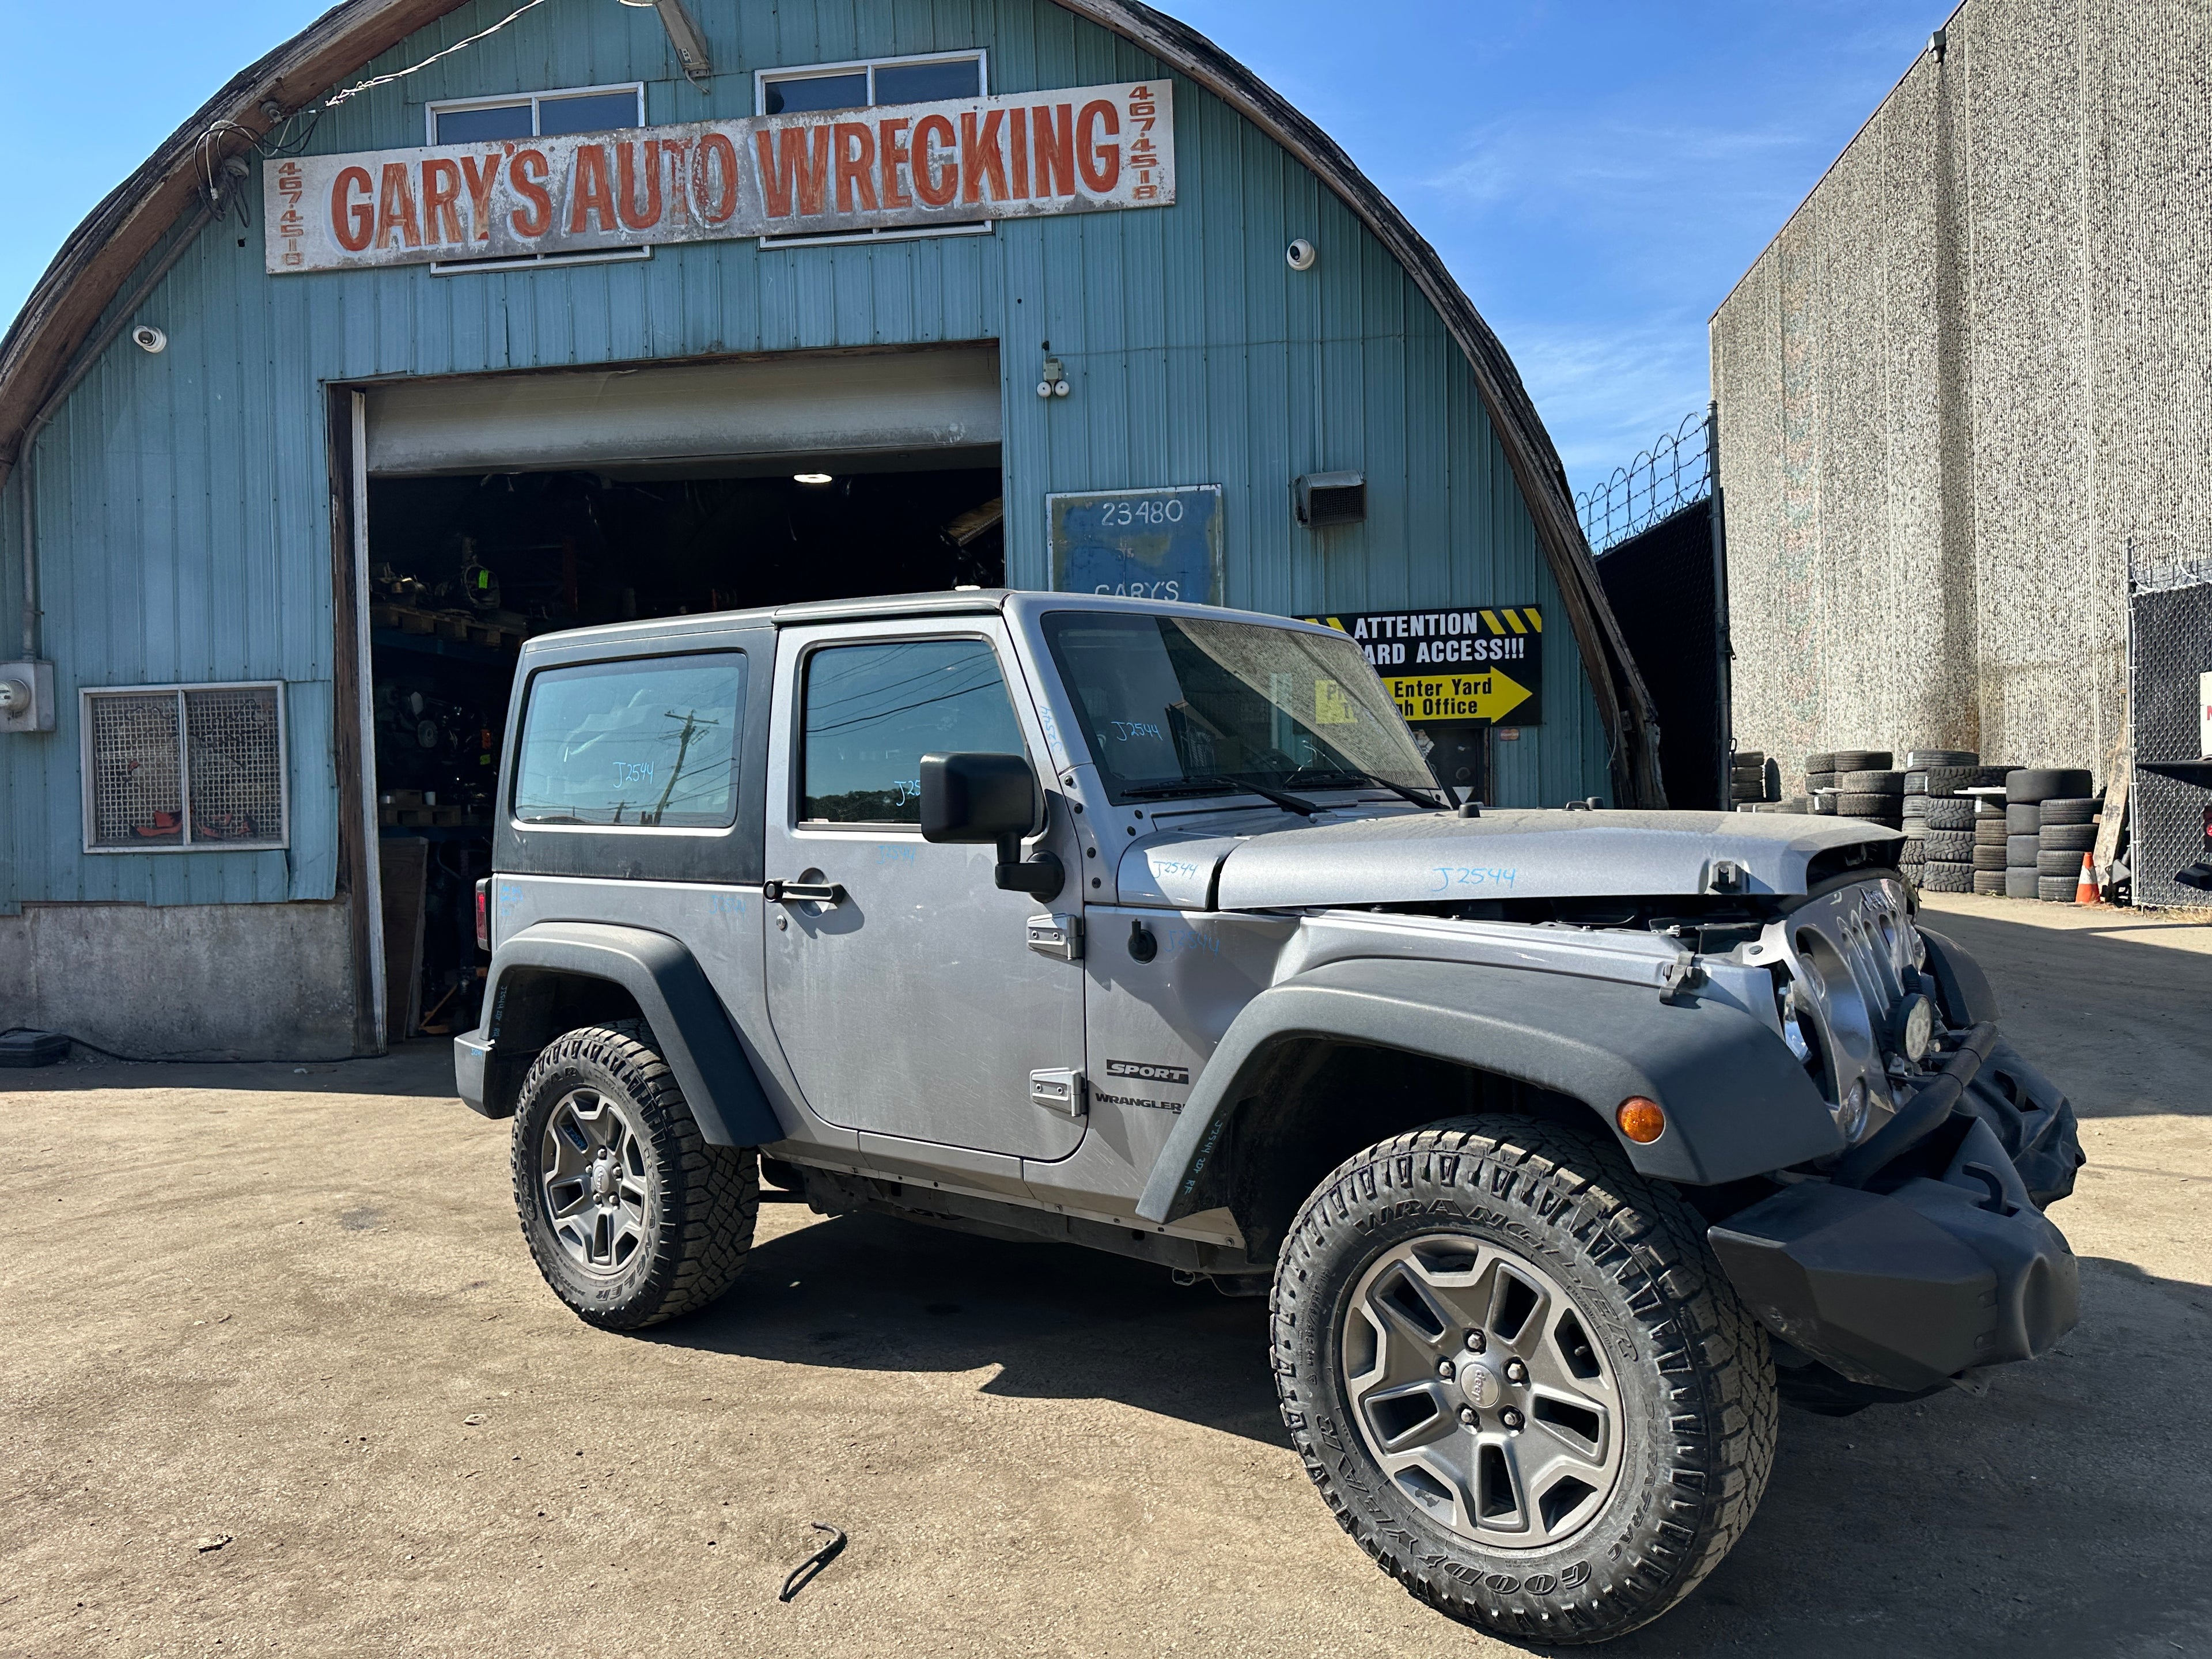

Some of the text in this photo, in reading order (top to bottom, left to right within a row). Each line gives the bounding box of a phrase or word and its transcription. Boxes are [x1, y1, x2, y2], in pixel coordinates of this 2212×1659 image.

[331, 99, 1120, 252] GARY'S AUTO WRECKING
[1101, 499, 1183, 526] 23480
[1354, 612, 1478, 639] ATTENTION
[1358, 638, 1524, 665] ARD ACCESS!!!
[1394, 677, 1492, 698] Enter Yard
[1423, 698, 1478, 715] Office
[1040, 705, 1062, 752] J2544
[1111, 721, 1163, 741] J2544
[612, 760, 654, 789] J2544
[894, 779, 921, 806] J25
[1152, 861, 1198, 880] J2544
[1431, 868, 1516, 892] J2544
[1107, 1062, 1188, 1081] SPORT
[1096, 1093, 1182, 1111] WRANGLER
[1353, 1198, 1638, 1361] WRANGLER
[1471, 1369, 1486, 1401] Jeep
